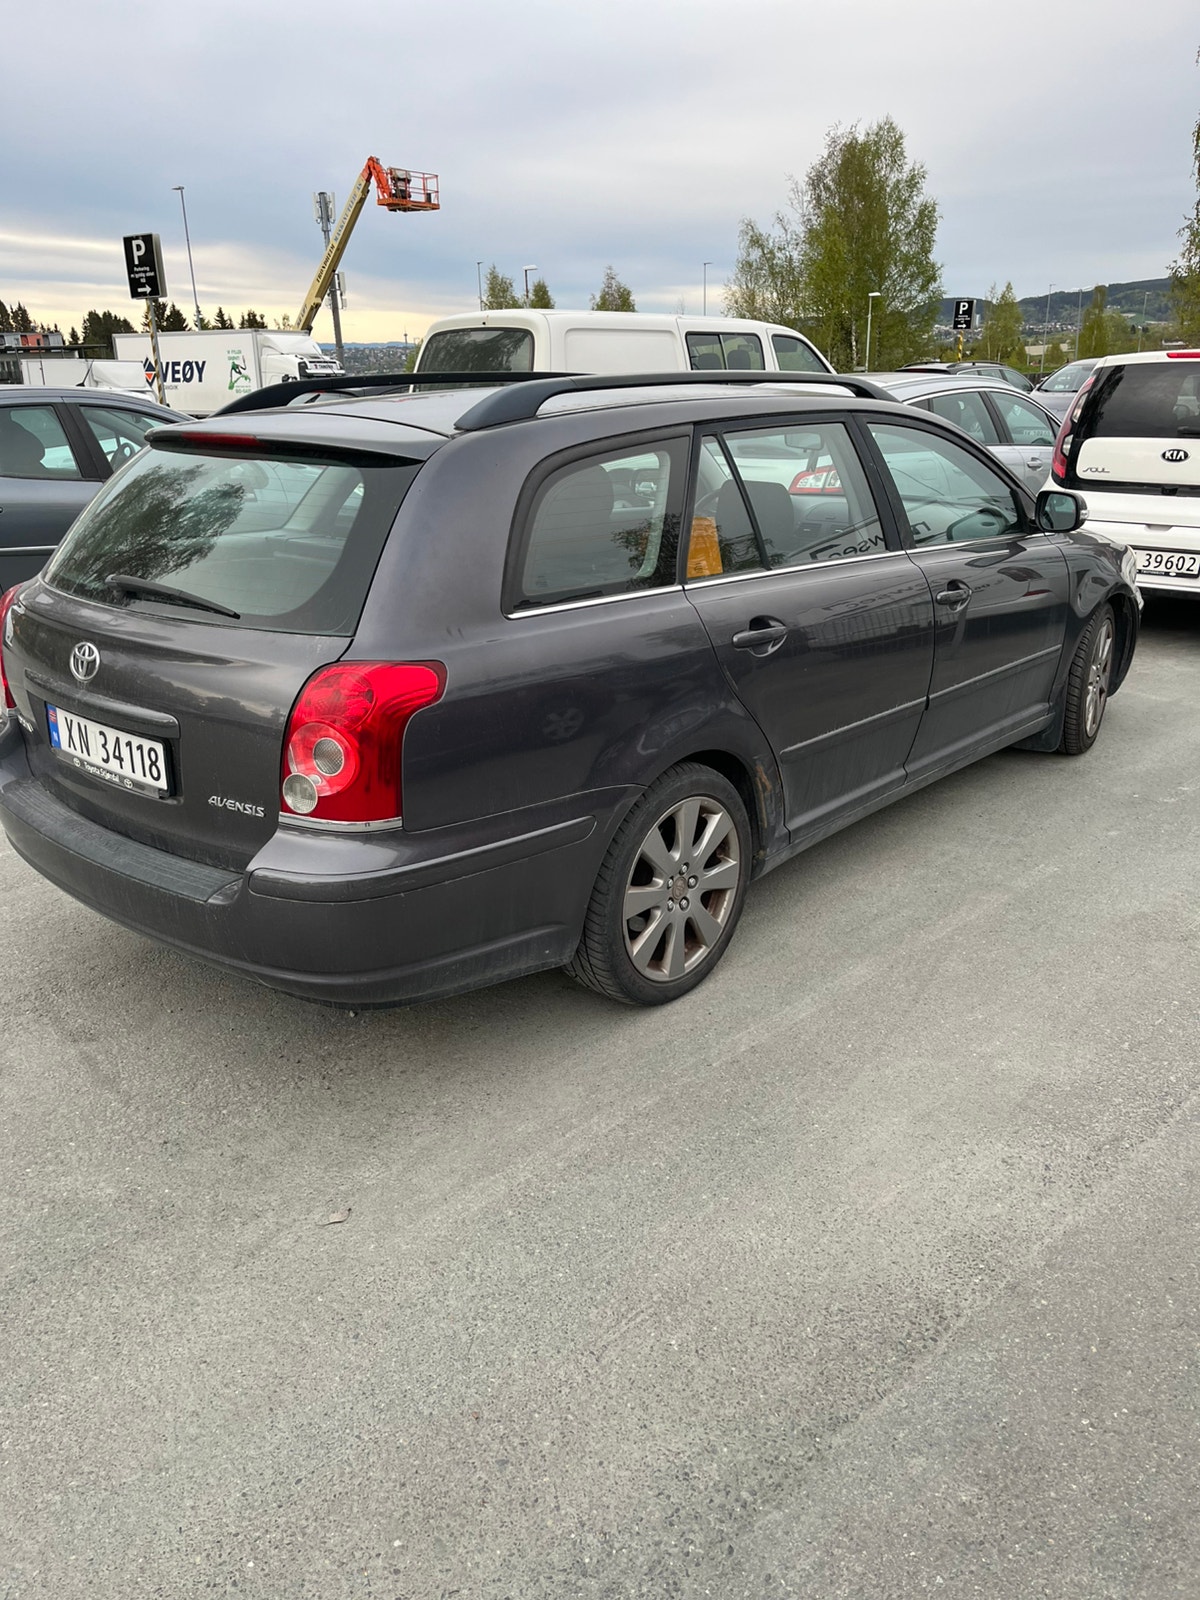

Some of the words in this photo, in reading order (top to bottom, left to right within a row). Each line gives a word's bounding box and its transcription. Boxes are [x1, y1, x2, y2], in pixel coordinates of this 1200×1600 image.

[131, 239, 146, 265] P
[959, 302, 969, 315] P
[159, 360, 207, 384] VEØY
[1164, 450, 1186, 460] KIA
[1082, 466, 1111, 474] SOUL
[1142, 552, 1197, 573] 39602
[64, 716, 91, 757] XN
[98, 730, 162, 782] 34118
[207, 795, 265, 818] AVENSIS
